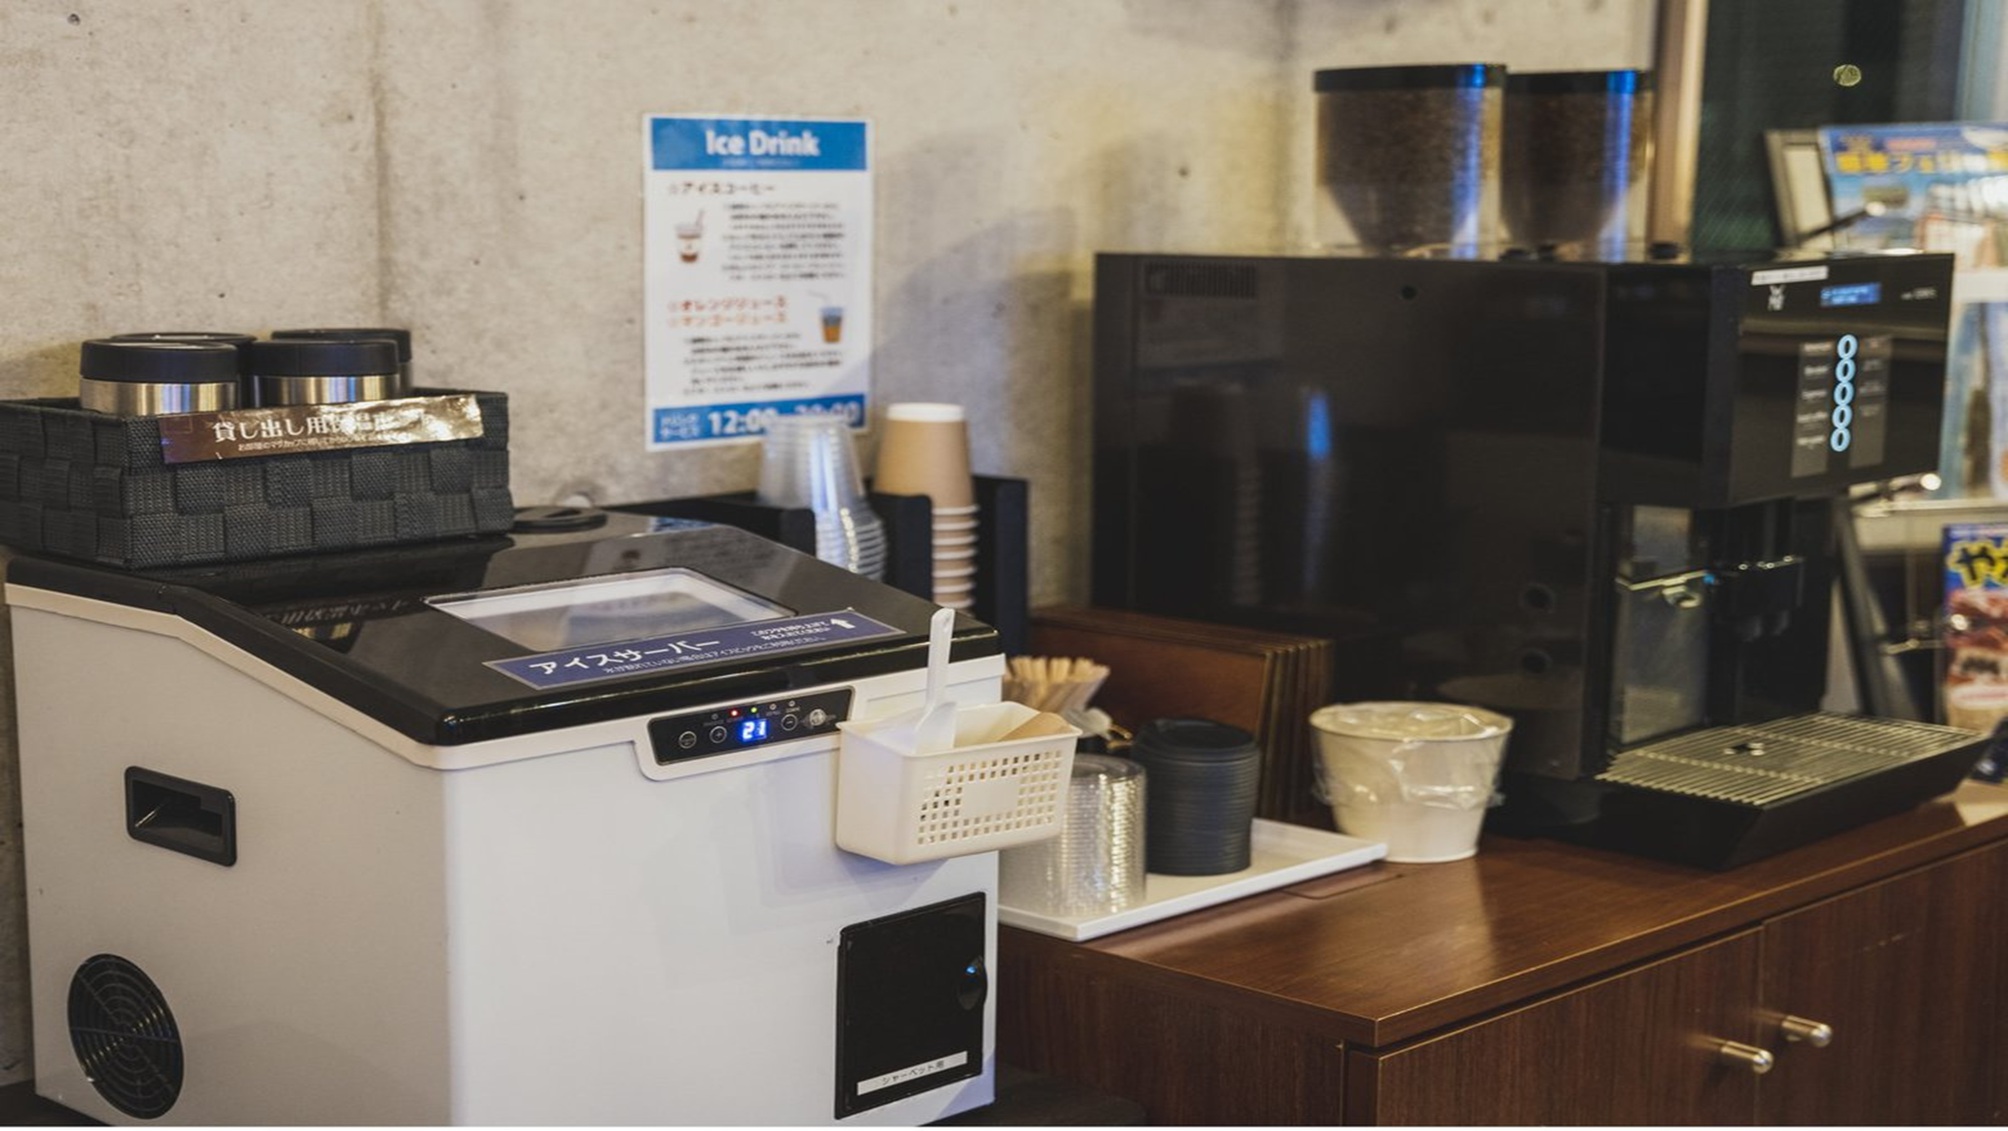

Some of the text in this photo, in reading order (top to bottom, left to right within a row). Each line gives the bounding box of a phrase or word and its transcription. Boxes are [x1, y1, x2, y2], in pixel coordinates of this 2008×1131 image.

[705, 129, 820, 156] Ice Drink
[529, 640, 720, 676] アイスサーバー
[741, 715, 768, 741] 21
[881, 1060, 946, 1086] シャーベット用
